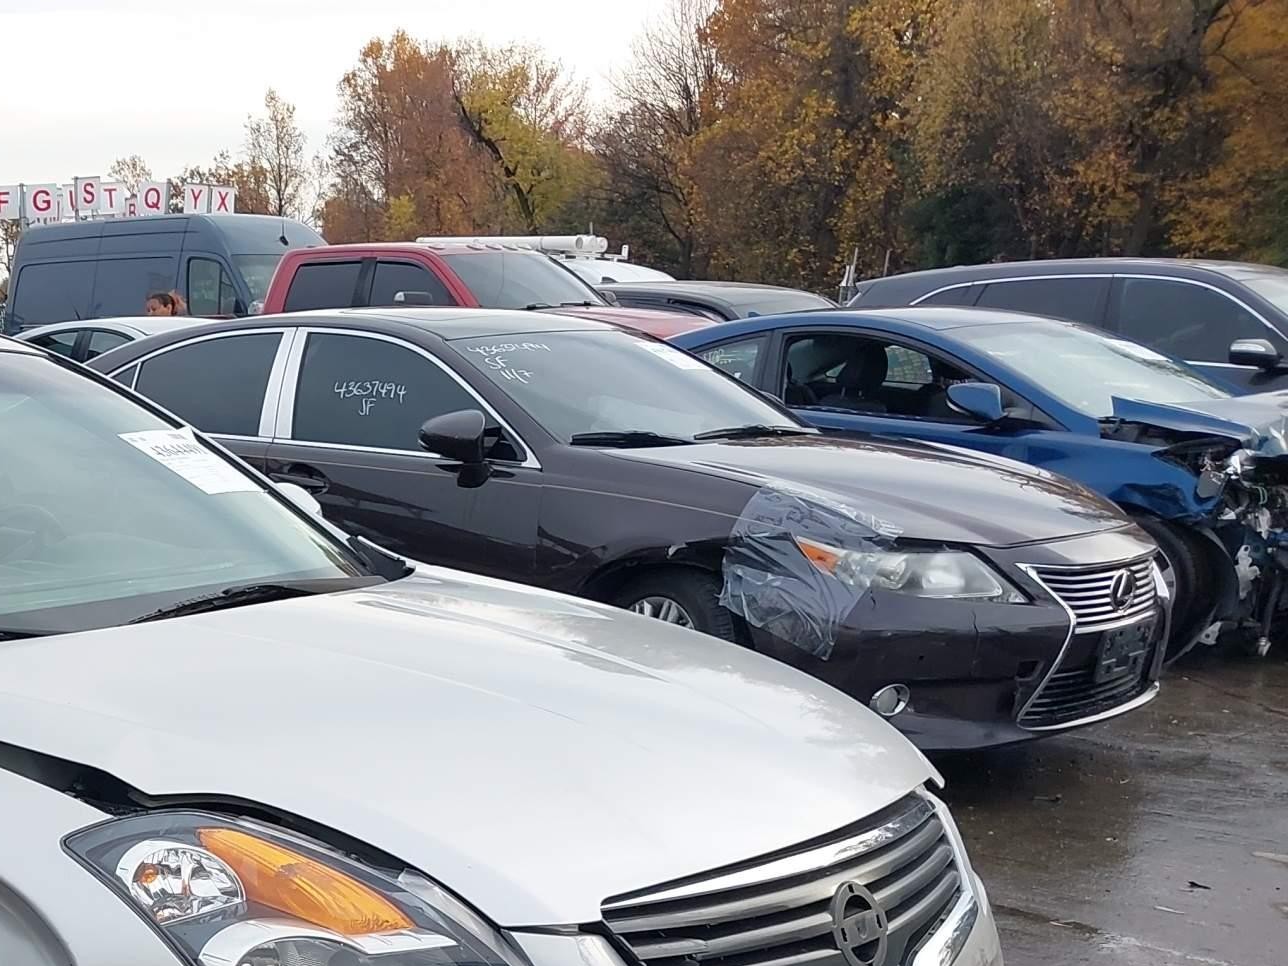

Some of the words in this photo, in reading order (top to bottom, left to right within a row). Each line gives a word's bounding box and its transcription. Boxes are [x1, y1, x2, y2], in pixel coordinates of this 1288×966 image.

[32, 189, 51, 211] G
[83, 182, 95, 204] S
[103, 188, 117, 208] T
[145, 187, 160, 210] Q
[191, 188, 202, 209] Y
[216, 191, 228, 212] X
[334, 381, 407, 404] 43637494
